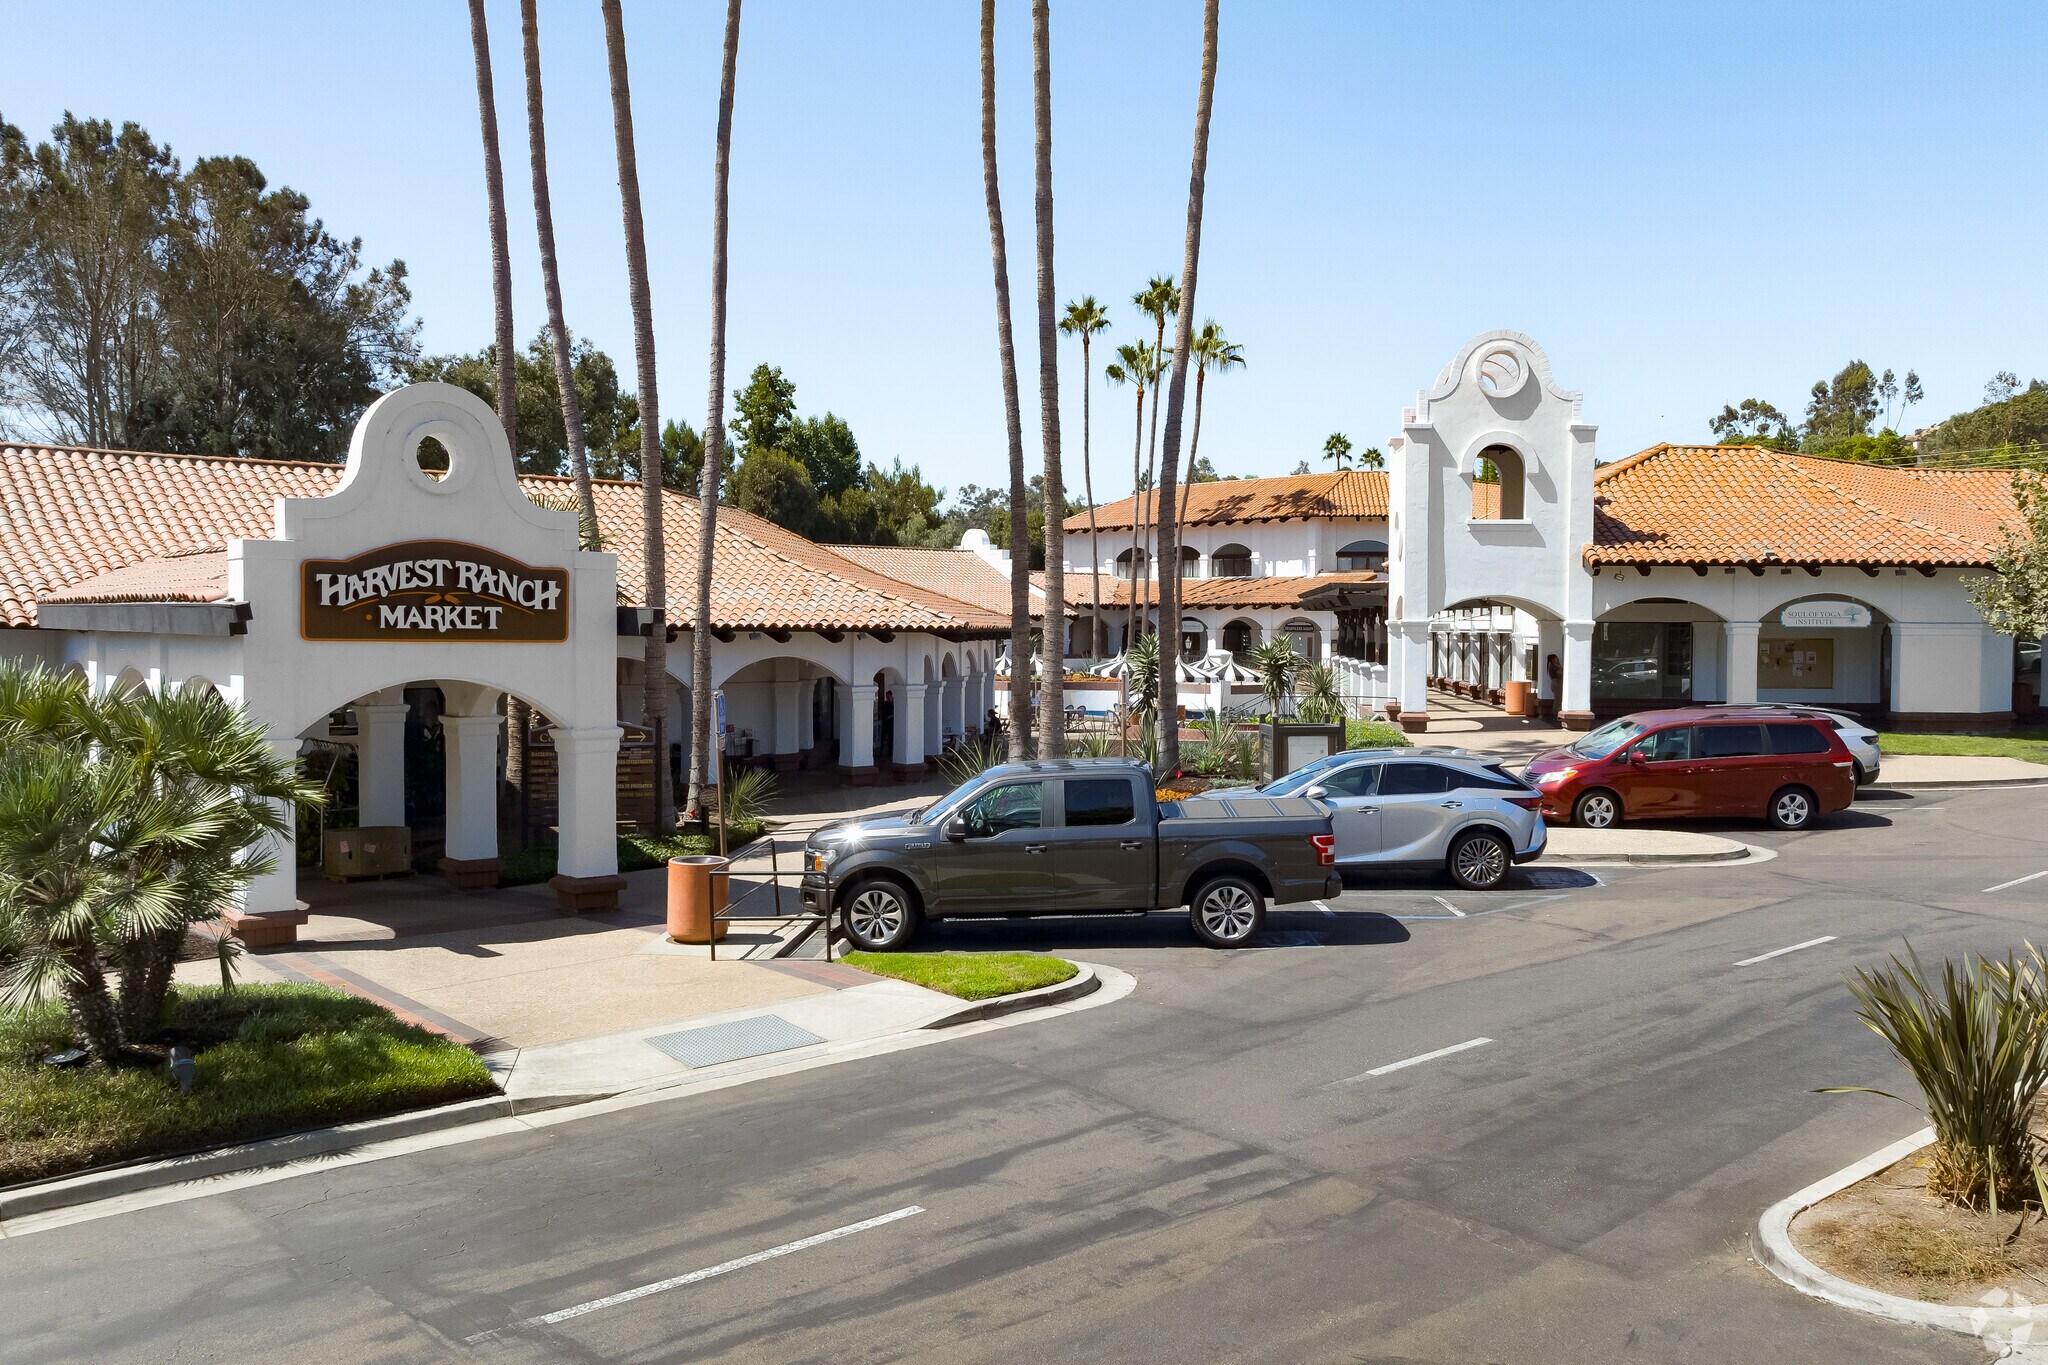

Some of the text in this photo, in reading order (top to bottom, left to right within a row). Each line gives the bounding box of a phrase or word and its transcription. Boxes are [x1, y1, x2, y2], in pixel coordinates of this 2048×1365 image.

[316, 559, 561, 610] HARVEST RANCH
[378, 604, 503, 633] MARKET
